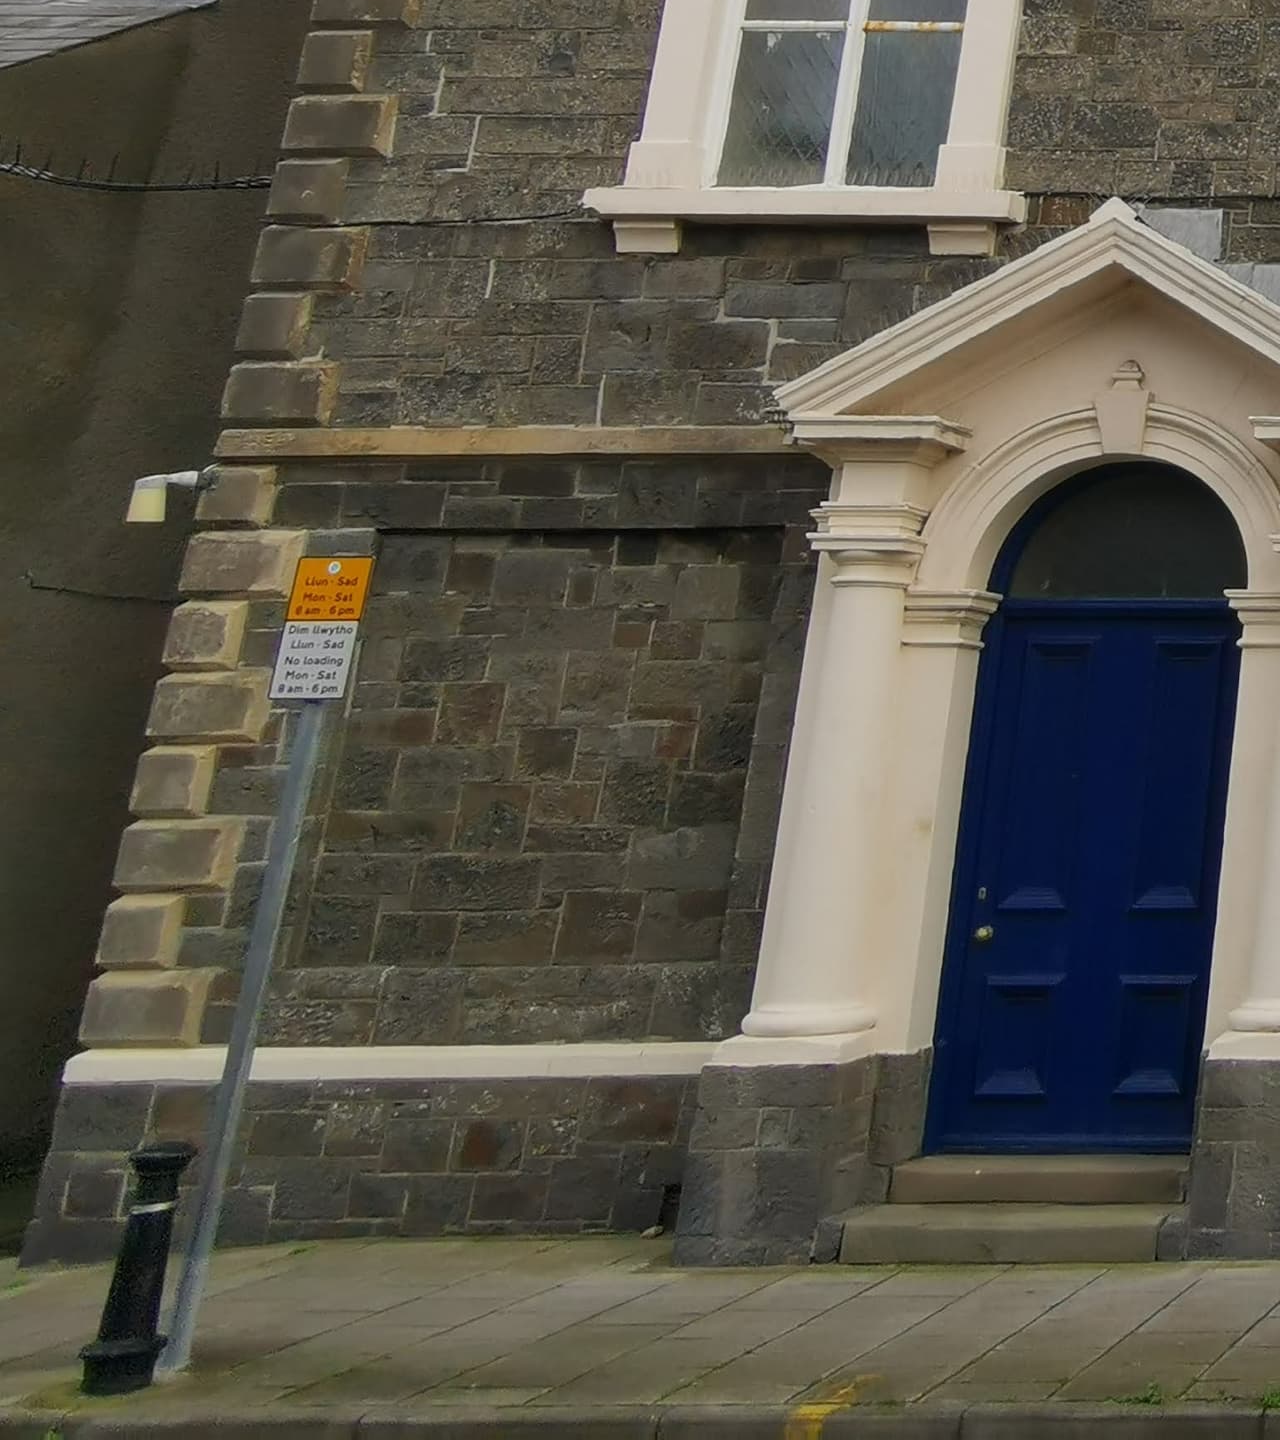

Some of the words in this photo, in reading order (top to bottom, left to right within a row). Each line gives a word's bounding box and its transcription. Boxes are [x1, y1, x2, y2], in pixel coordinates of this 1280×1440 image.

[336, 576, 359, 585] Sad
[303, 592, 326, 602] Mon
[334, 592, 353, 601] Sat
[338, 607, 355, 616] pm
[288, 625, 310, 634] Dim
[312, 625, 354, 636] llwytho
[324, 640, 345, 649] Sad
[284, 656, 300, 665] No
[303, 656, 344, 667] loading
[285, 671, 308, 680] Mon
[316, 671, 336, 680] Sat
[311, 684, 319, 693] 6
[319, 686, 338, 695] pm
